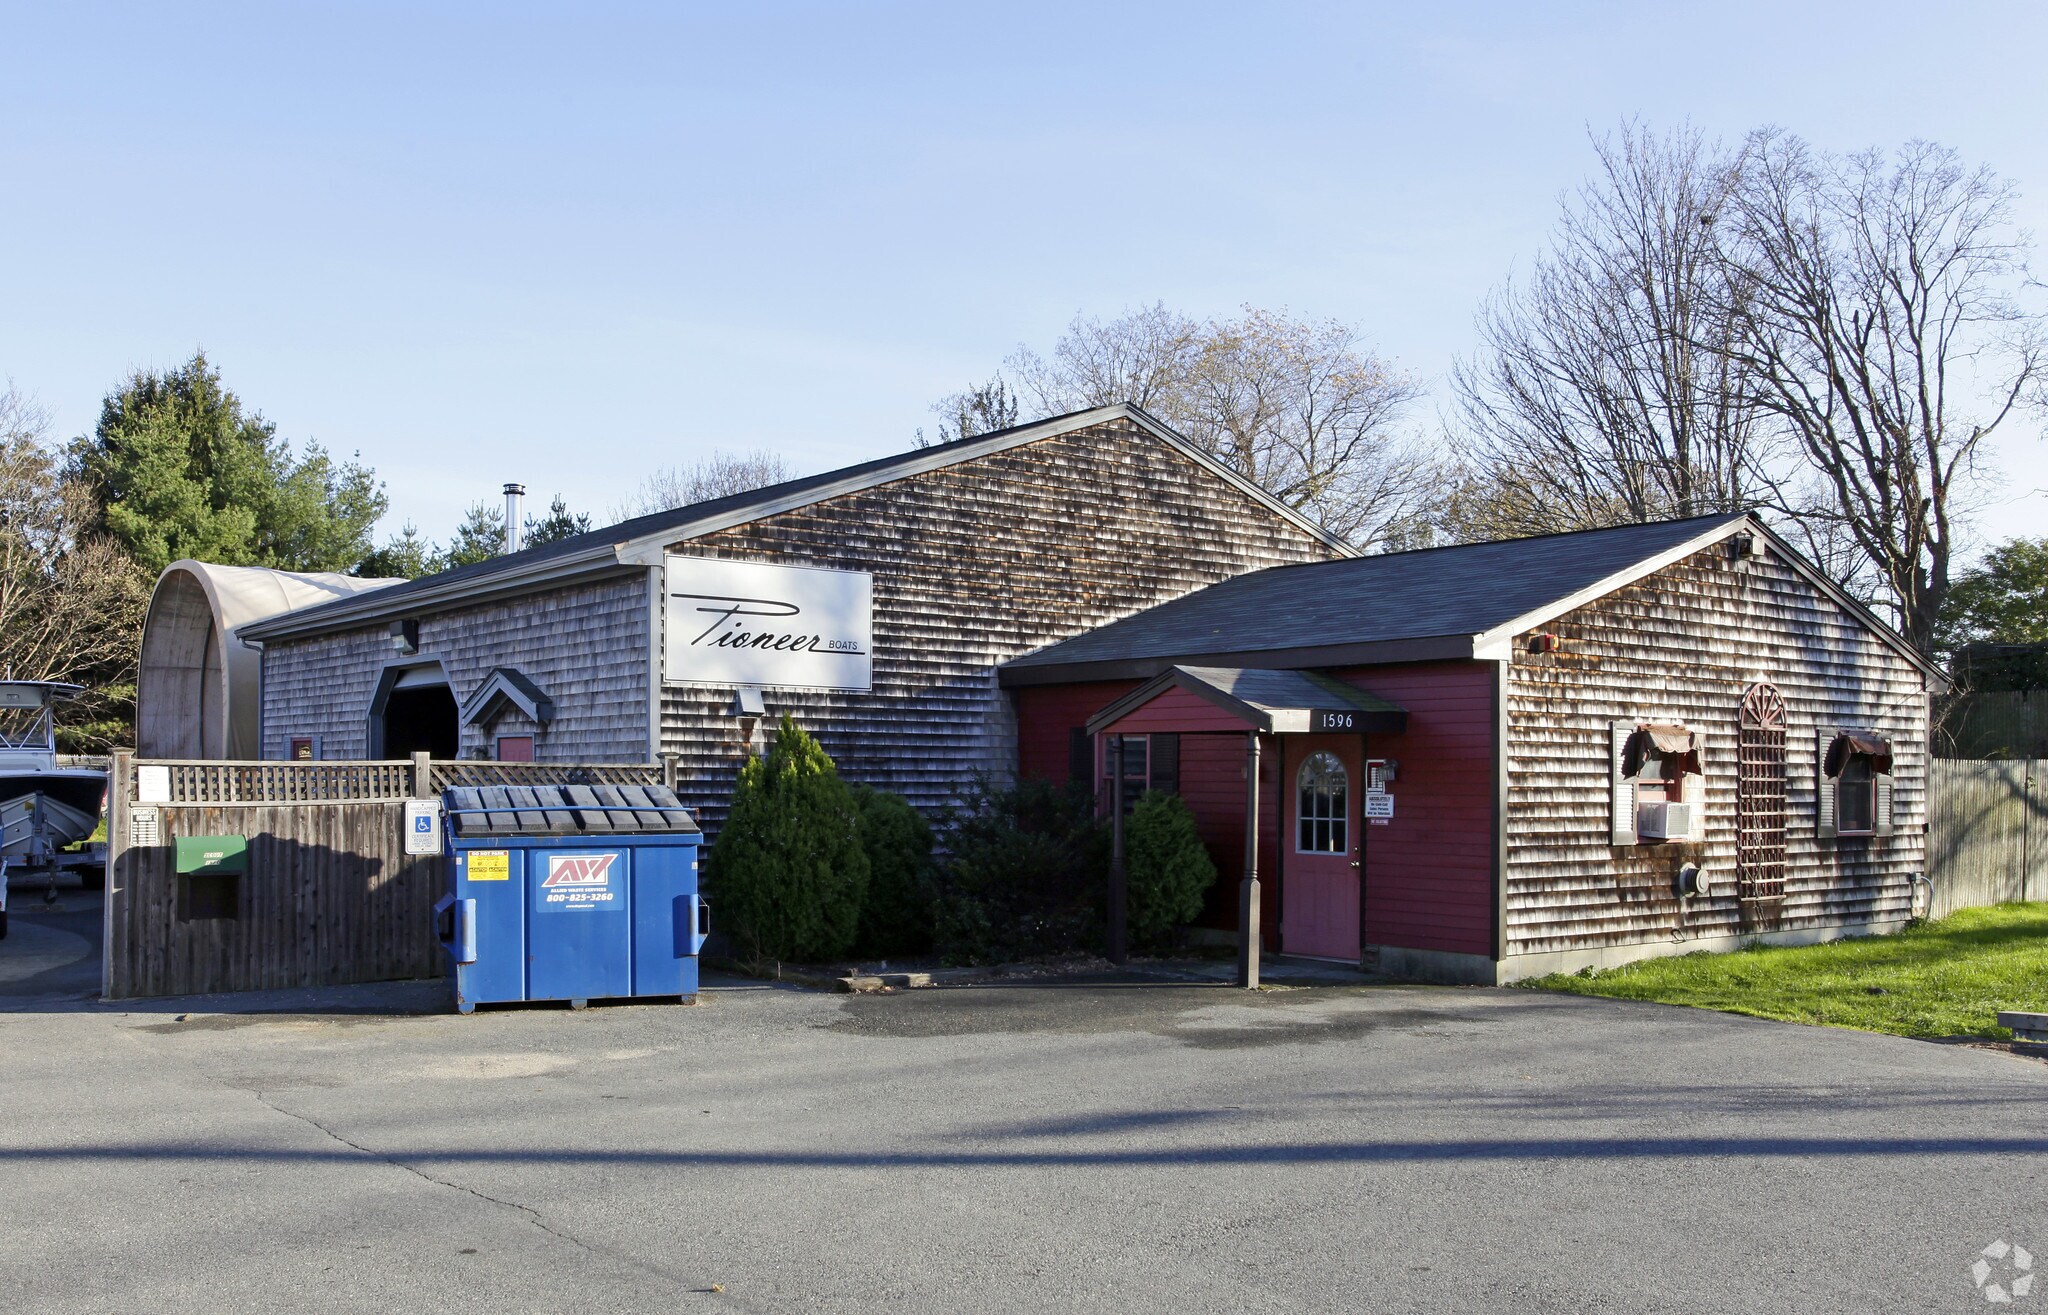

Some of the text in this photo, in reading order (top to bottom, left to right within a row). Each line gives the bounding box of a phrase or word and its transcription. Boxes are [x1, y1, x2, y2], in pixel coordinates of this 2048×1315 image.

[671, 593, 865, 655] Pioneer BOATS
[1323, 713, 1352, 728] 1596
[546, 893, 613, 902] 800-825-3260
